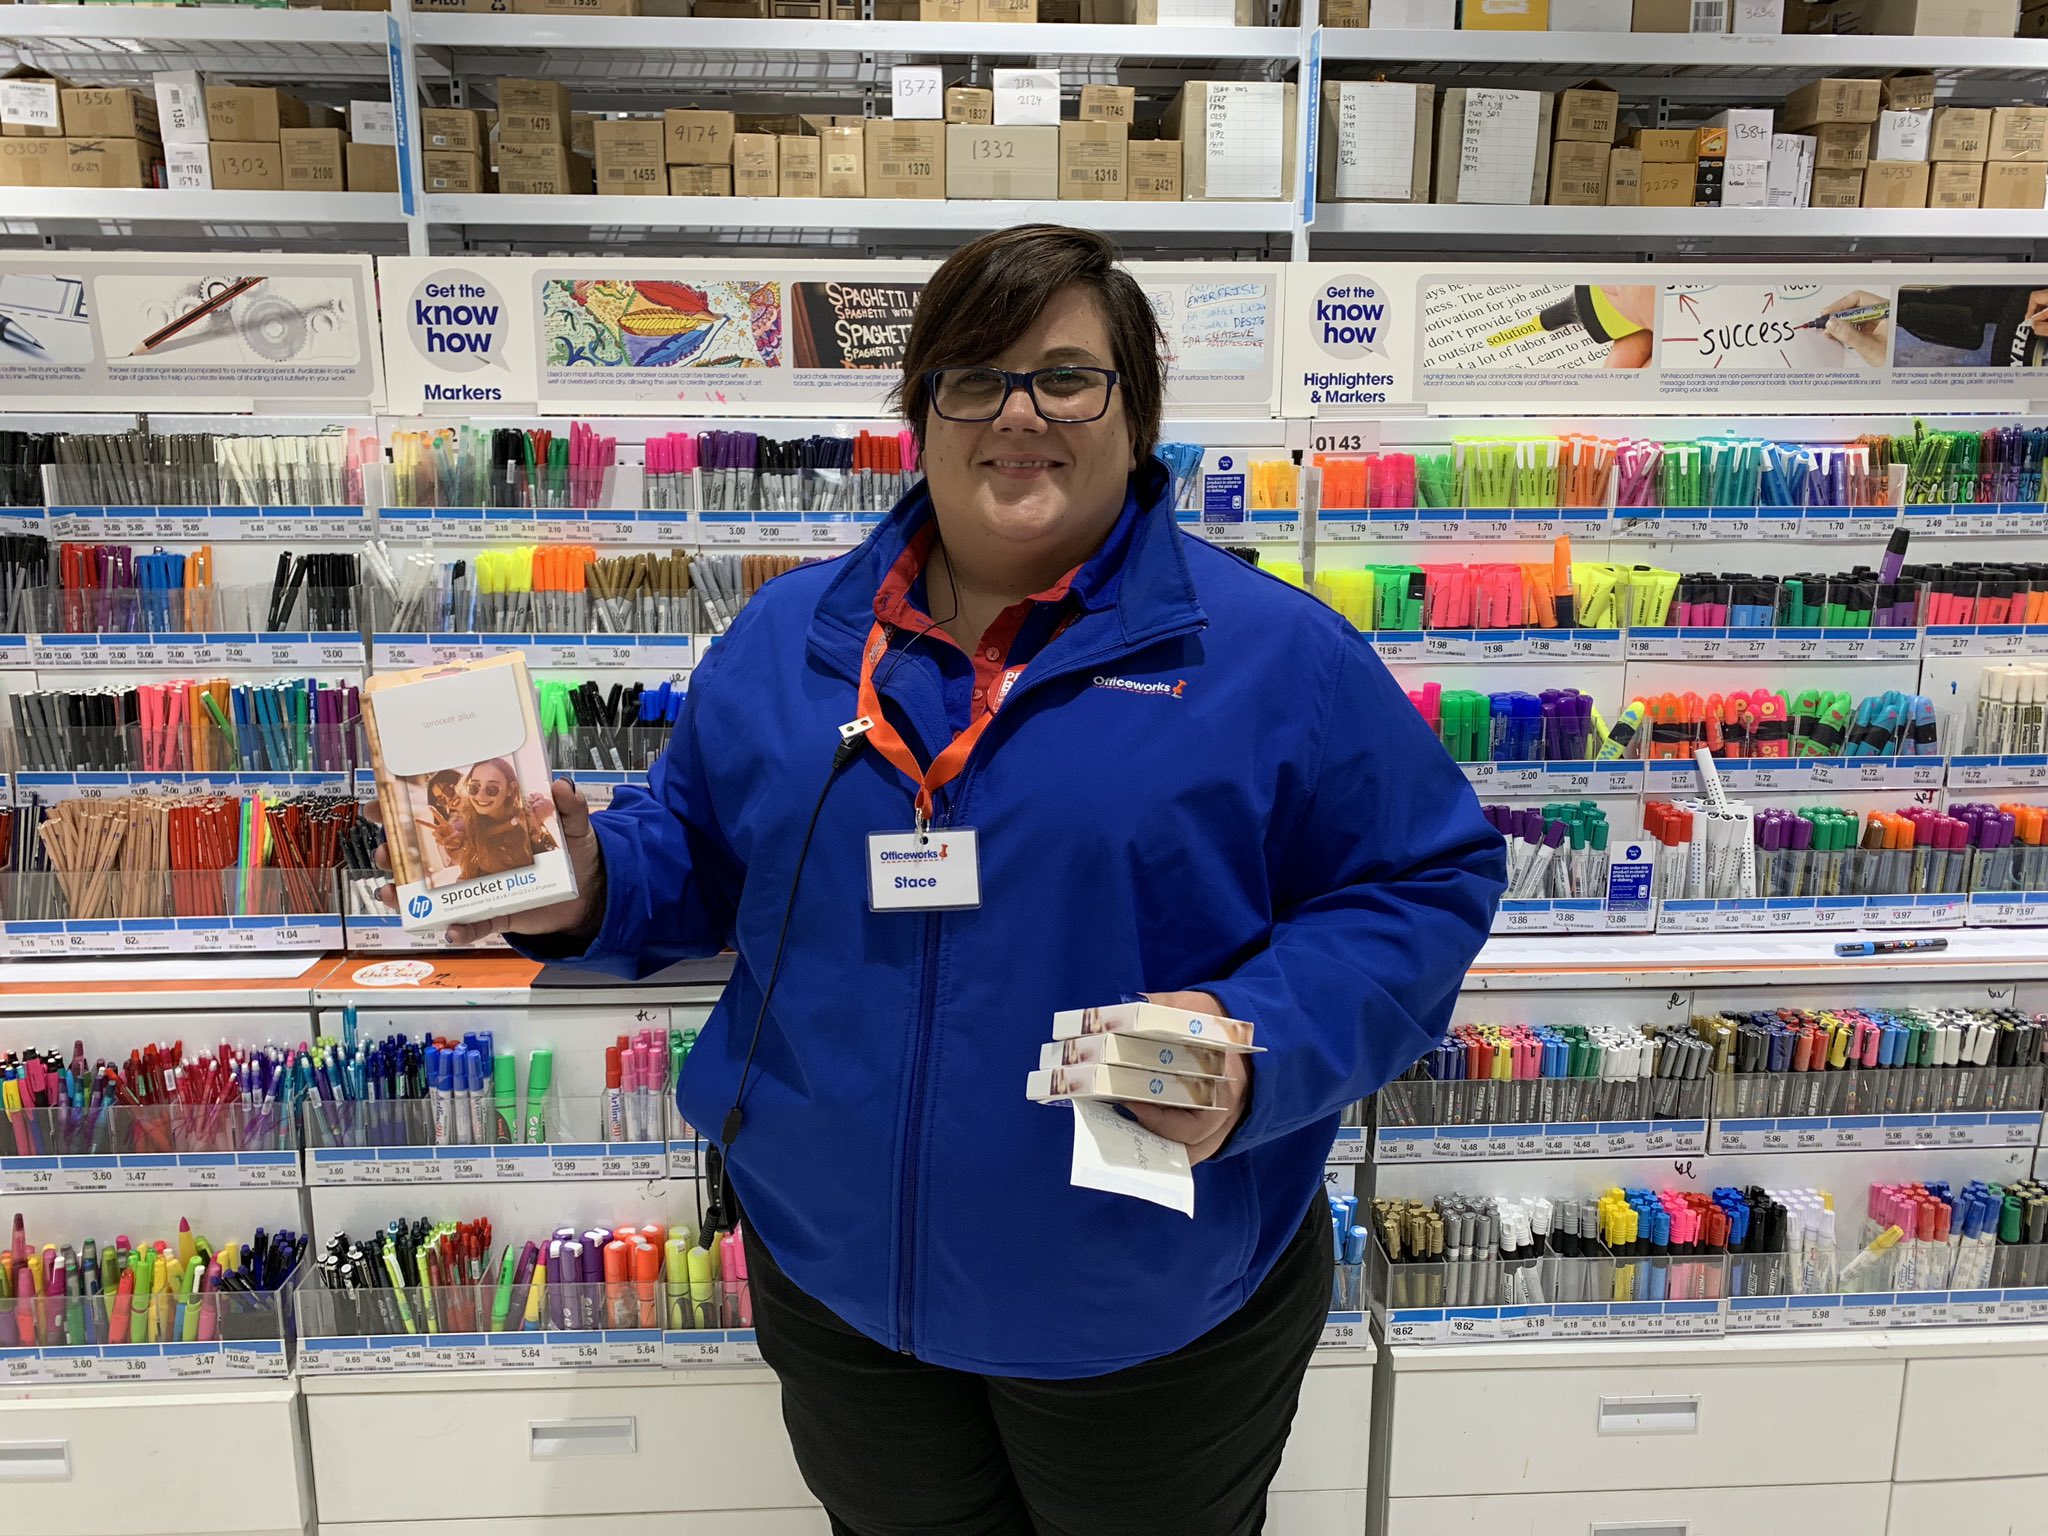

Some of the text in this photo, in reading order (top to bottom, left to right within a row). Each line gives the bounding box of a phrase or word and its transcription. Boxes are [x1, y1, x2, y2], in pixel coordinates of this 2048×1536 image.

[898, 79, 937, 97] 1377
[76, 92, 112, 105] 1356
[29, 110, 49, 119] 2173
[171, 108, 185, 129] 1356
[969, 108, 987, 120] 1837
[1105, 105, 1125, 118] 1745
[530, 117, 551, 131] 1479
[1593, 120, 1608, 130] 2278
[1893, 117, 1921, 130] 1853
[1735, 124, 1767, 140] 1384
[4, 142, 49, 156] 0305
[972, 140, 1016, 160] 1332
[1961, 140, 1978, 151] 1264
[186, 163, 203, 175] 1769
[222, 157, 269, 176] 1303
[312, 166, 334, 180] 2100
[907, 163, 931, 176] 1370
[1881, 167, 1913, 179] 4735
[632, 168, 656, 181] 1455
[1094, 168, 1118, 182] 1318
[532, 181, 554, 194] 1752
[1154, 178, 1174, 192] 2421
[1581, 182, 1600, 194] 1868
[1840, 195, 1855, 205] 1585
[425, 283, 486, 298] Get the
[825, 282, 908, 309] SPAGHETTI
[1326, 285, 1375, 299] Get the
[1457, 292, 1485, 304] The
[1486, 301, 1505, 313] for
[1506, 293, 1527, 309] job
[1529, 284, 1551, 299] and
[415, 299, 499, 326] know
[834, 305, 886, 320] SPAGHETTI
[1315, 300, 1385, 322] know
[1323, 322, 1377, 344] how
[1428, 308, 1534, 348] don't provide for
[427, 327, 492, 353] how
[1438, 323, 1537, 363] outsize solution
[1477, 325, 1572, 366] lot of labor and
[843, 346, 894, 362] SPAGHETTI
[1526, 342, 1579, 367] Learn to
[1303, 372, 1394, 390] Highlighters
[424, 384, 502, 401] Markers
[1310, 390, 1386, 403] & Markers
[1315, 436, 1362, 452] 0143
[616, 523, 632, 533] 3.00
[1924, 517, 1942, 527] 2.49
[729, 527, 745, 535] 3.00
[1092, 675, 1172, 693] Officeworks
[422, 710, 477, 729] sprocket plus
[1521, 770, 1537, 780] 2.00
[2030, 767, 2046, 777] 2.20
[881, 849, 938, 861] Officeworks
[441, 879, 503, 905] sprocket
[505, 872, 537, 891] plus
[894, 876, 937, 889] Stace
[412, 896, 430, 919] hp
[611, 1092, 622, 1124] Artline
[34, 1171, 52, 1182] 3.47
[93, 1172, 111, 1180] 3.60
[1978, 1306, 1995, 1314] 5.98
[1526, 1318, 1544, 1327] 6.18
[522, 1347, 540, 1357] 5.64
[637, 1346, 655, 1354] 5.64
[73, 1360, 92, 1368] 3.60
[196, 1355, 214, 1365] 3.47
